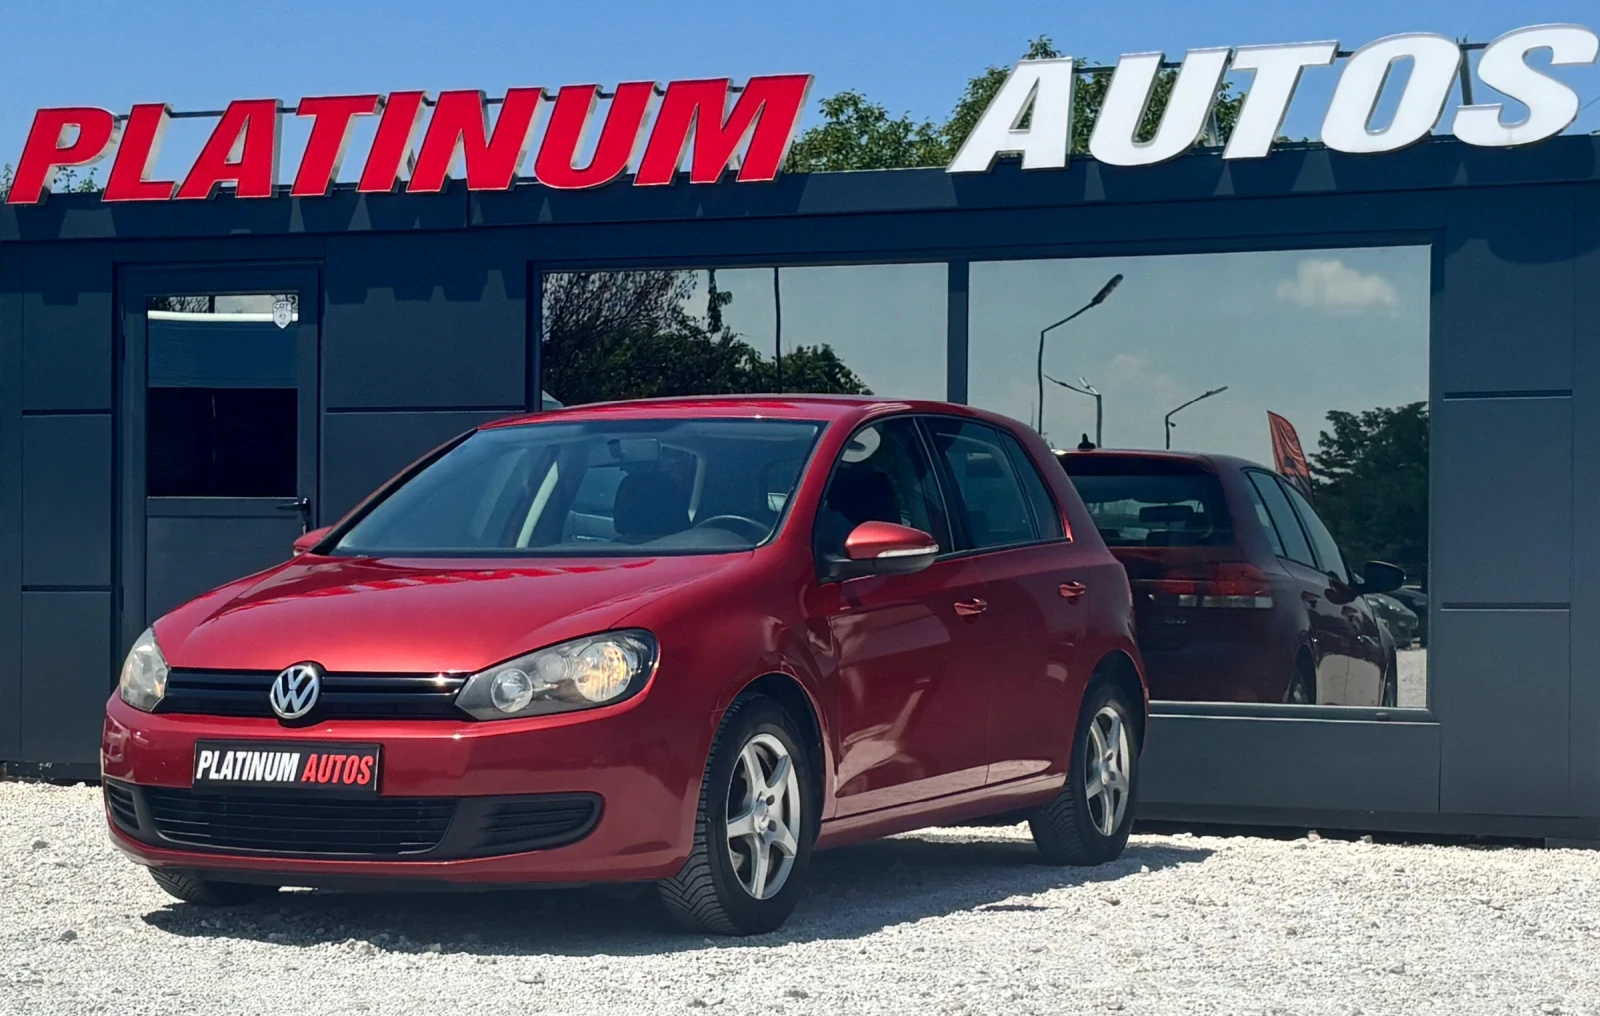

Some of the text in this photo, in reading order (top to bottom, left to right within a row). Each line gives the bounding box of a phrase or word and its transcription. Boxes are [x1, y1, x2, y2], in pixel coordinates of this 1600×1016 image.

[7, 23, 1599, 204] PLATINUM AUTOS
[271, 665, 319, 717] VW
[196, 750, 374, 785] PLATINUM AUTOS
